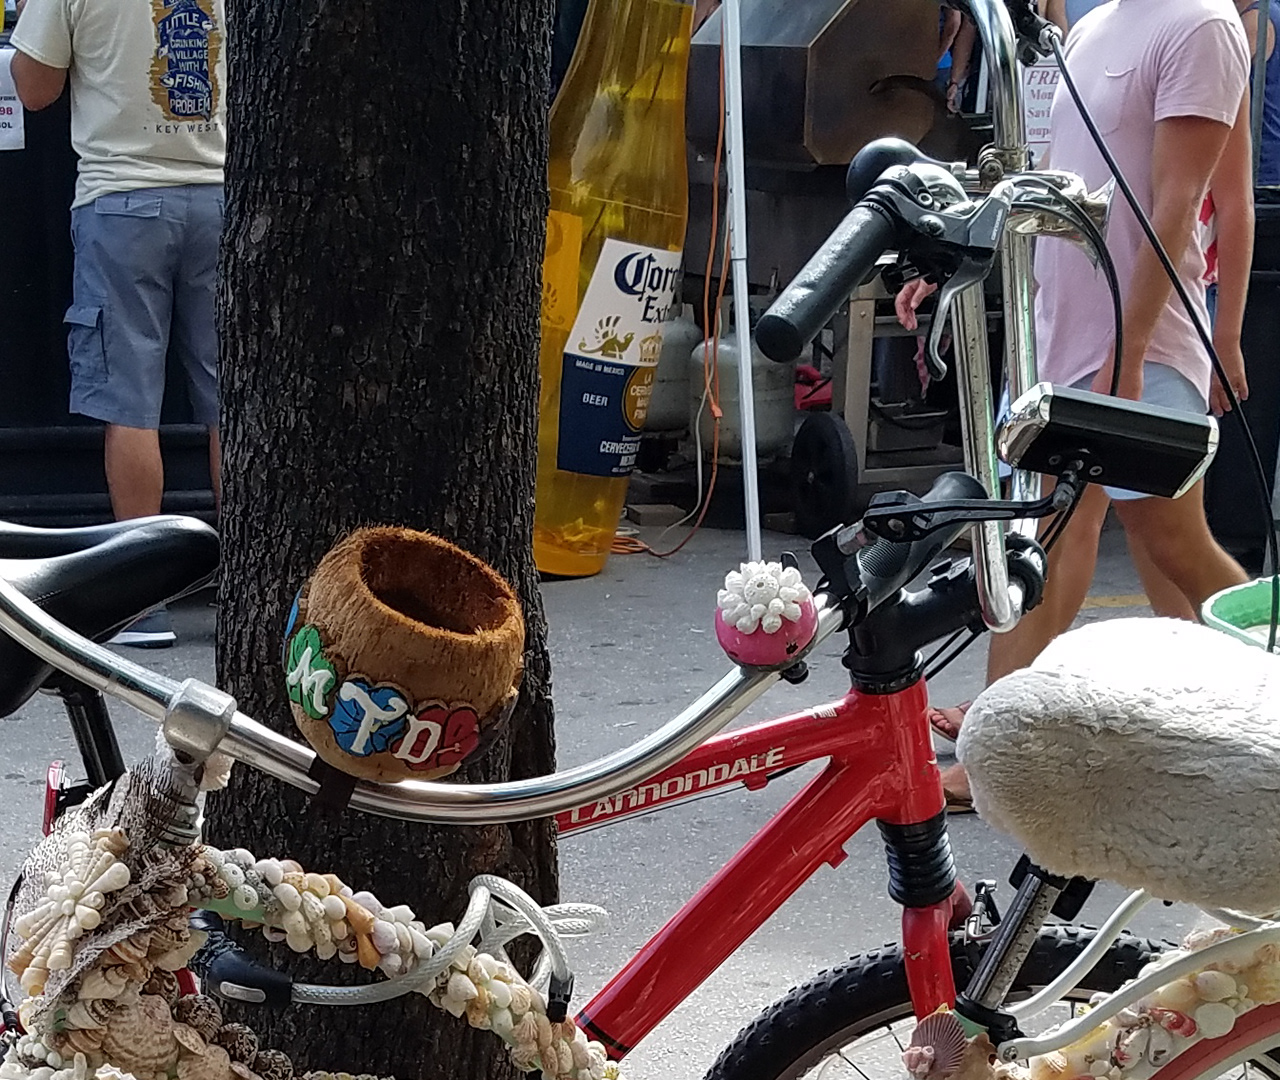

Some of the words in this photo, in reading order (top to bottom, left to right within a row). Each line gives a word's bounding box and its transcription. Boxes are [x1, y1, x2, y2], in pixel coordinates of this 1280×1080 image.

[166, 12, 200, 34] LITTLE
[170, 39, 208, 49] DRINKING
[175, 50, 209, 59] VILLAGE
[179, 61, 200, 72] WITH
[202, 61, 209, 71] A
[174, 74, 210, 93] FISHING
[170, 98, 211, 114] PROBLEM
[156, 125, 180, 134] KEY
[187, 123, 219, 134] WEST
[582, 392, 609, 407] BEER
